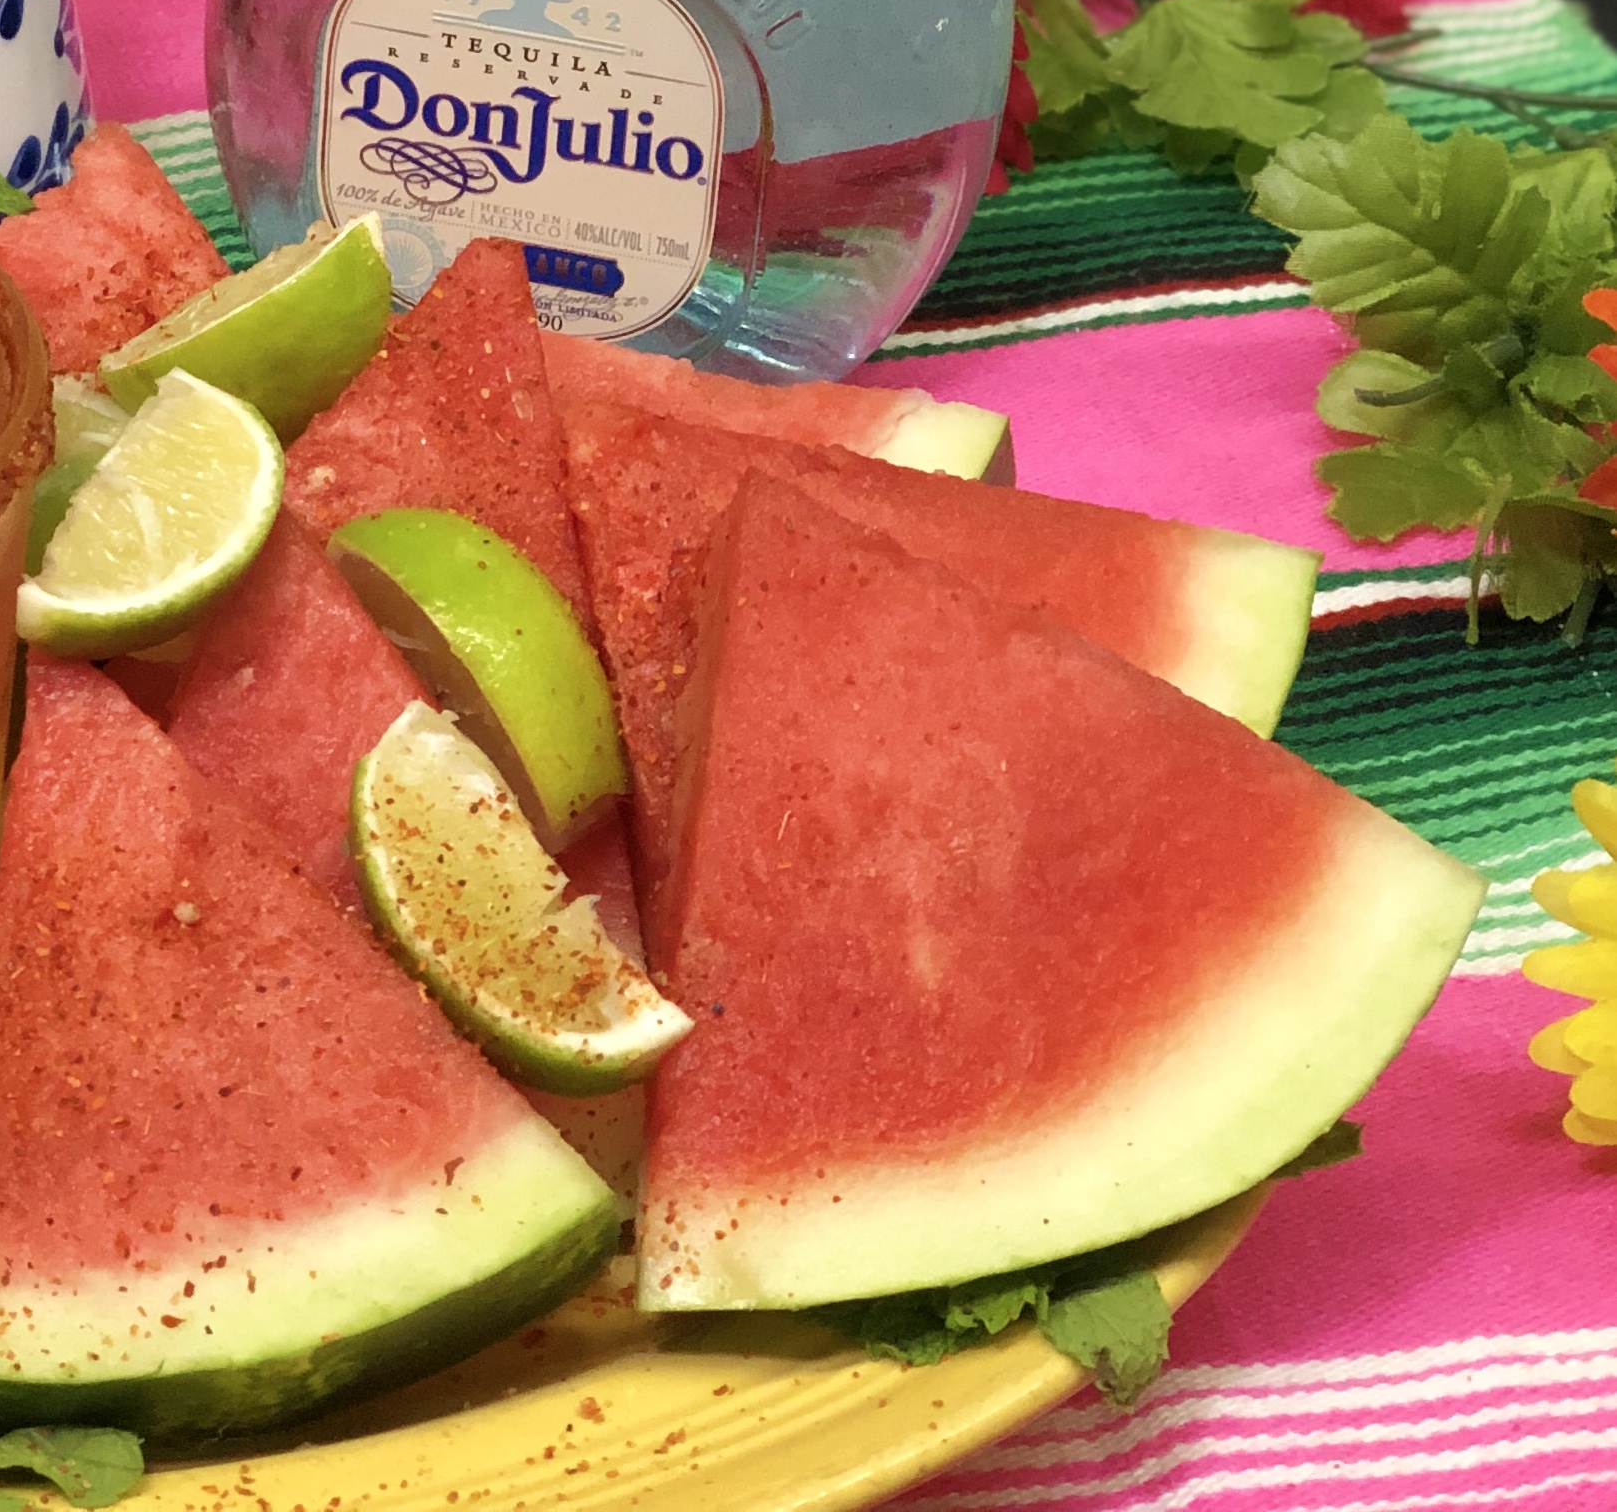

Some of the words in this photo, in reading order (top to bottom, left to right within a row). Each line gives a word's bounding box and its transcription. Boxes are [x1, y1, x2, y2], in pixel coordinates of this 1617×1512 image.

[440, 32, 613, 78] TEQUILA
[336, 183, 380, 202] 100%
[381, 189, 402, 208] de
[403, 196, 466, 222] Agave
[480, 203, 535, 221] HECHO
[542, 214, 562, 226] EN
[535, 253, 608, 287] ANCO
